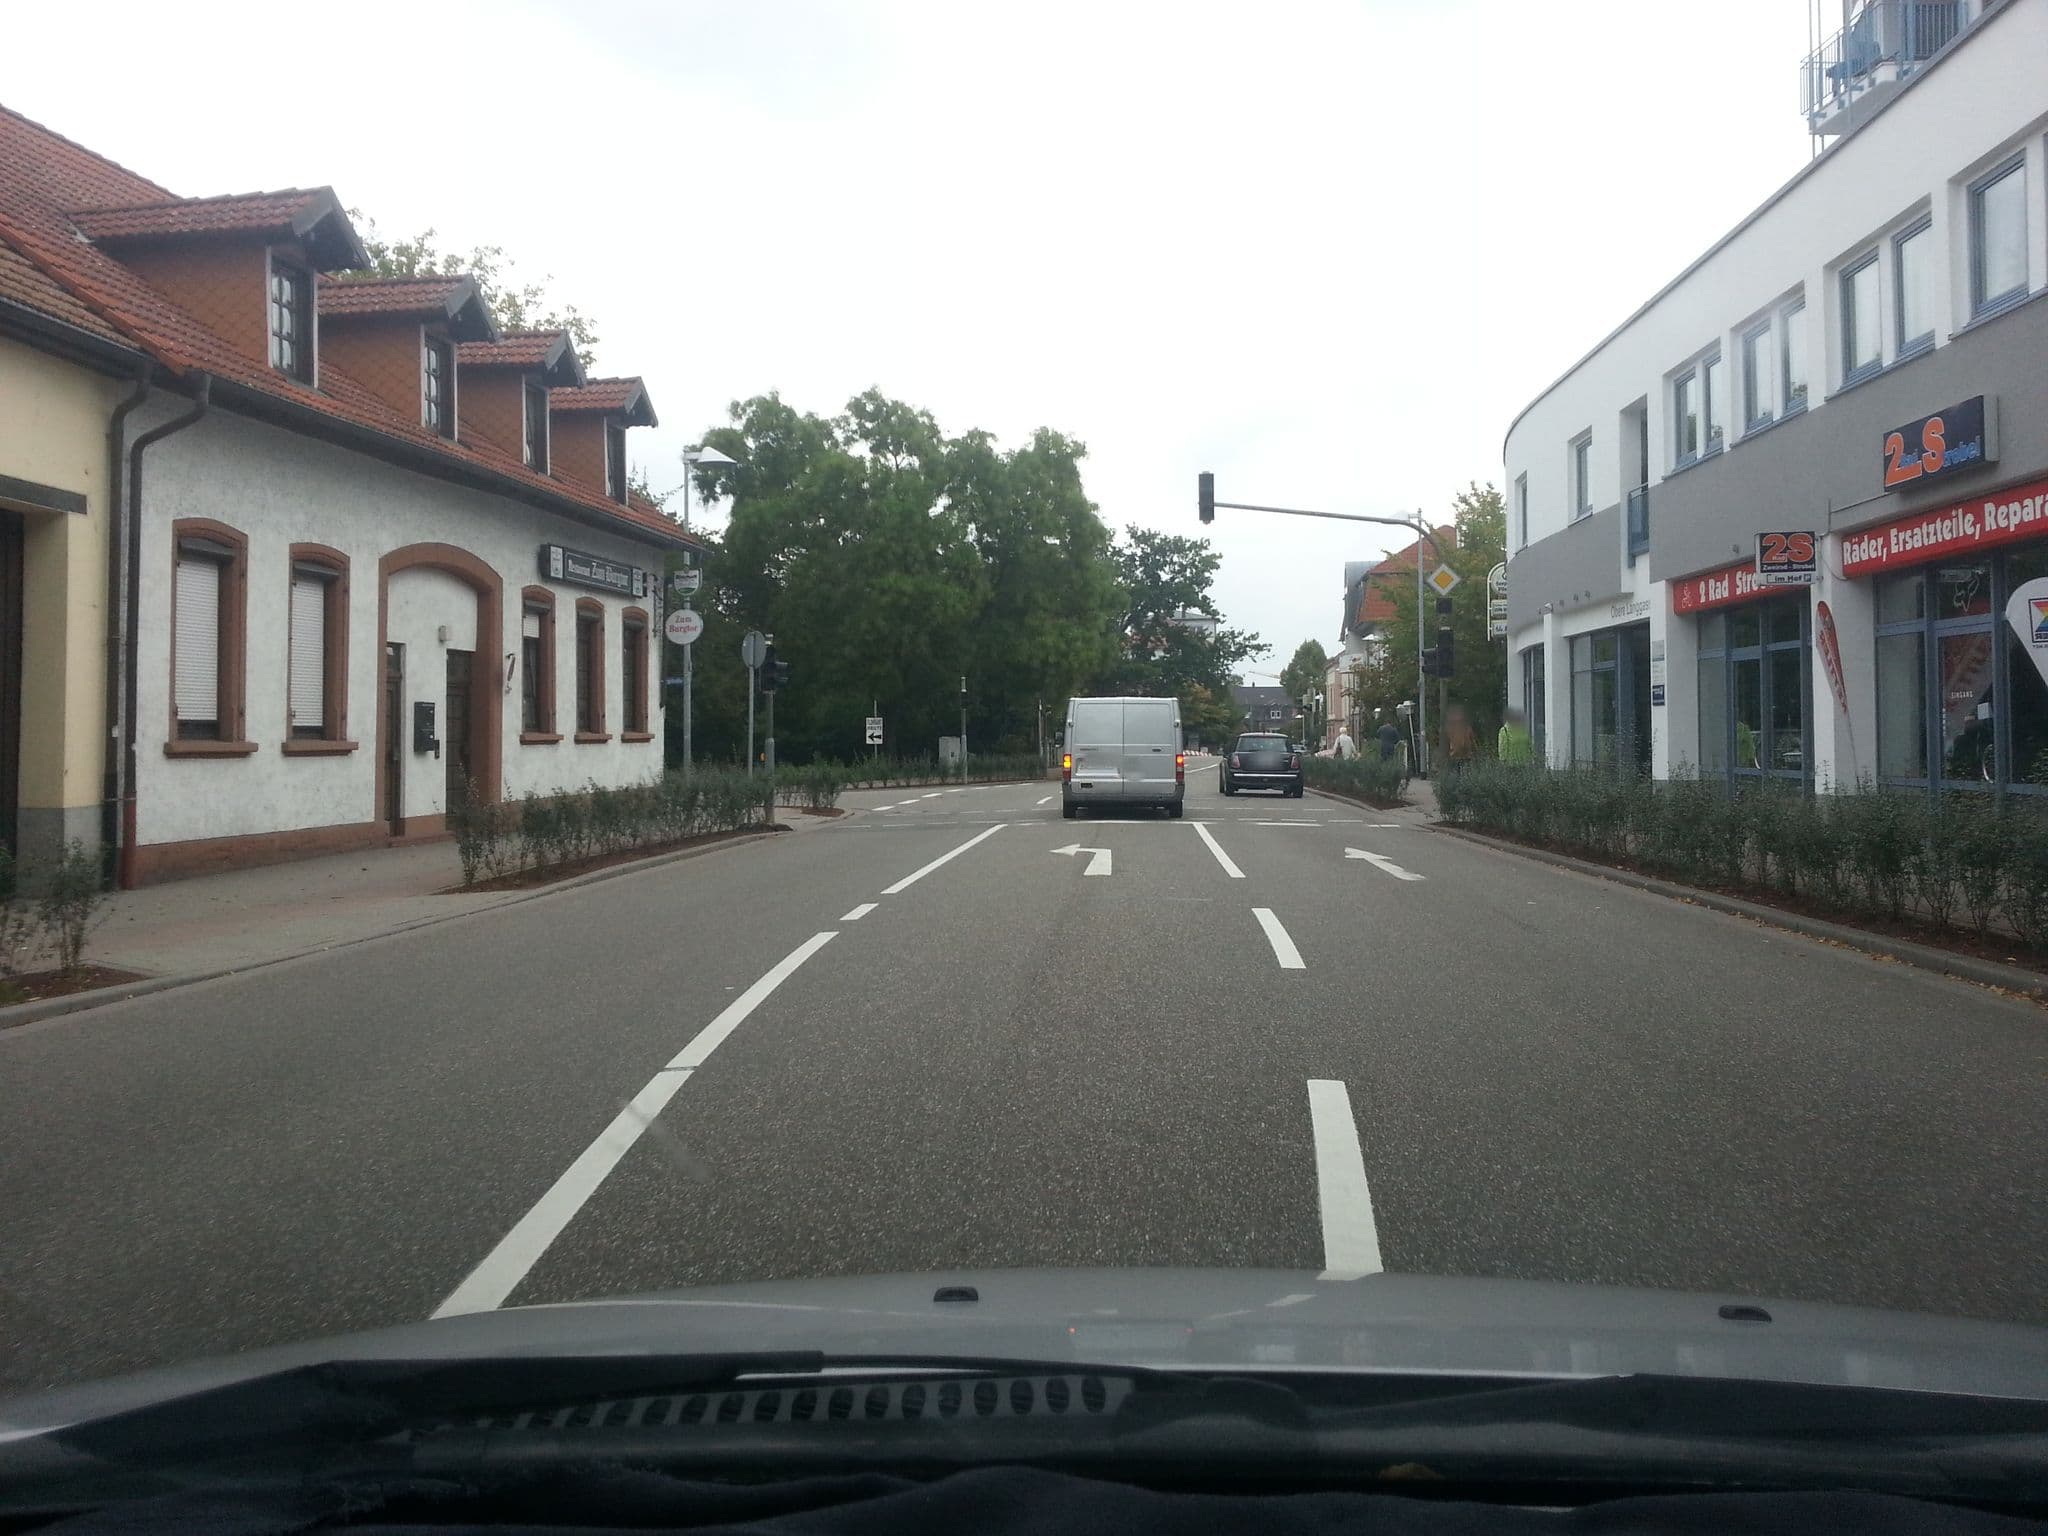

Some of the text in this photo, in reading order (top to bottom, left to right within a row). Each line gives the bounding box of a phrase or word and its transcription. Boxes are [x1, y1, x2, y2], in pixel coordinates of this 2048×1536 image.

[1762, 533, 1815, 563] 2S
[1843, 534, 1887, 565] Räder,
[1890, 508, 1981, 554] Ersatzteile,
[1699, 580, 1706, 603] 2
[1708, 573, 1729, 601] Rad
[675, 615, 692, 623] Zum
